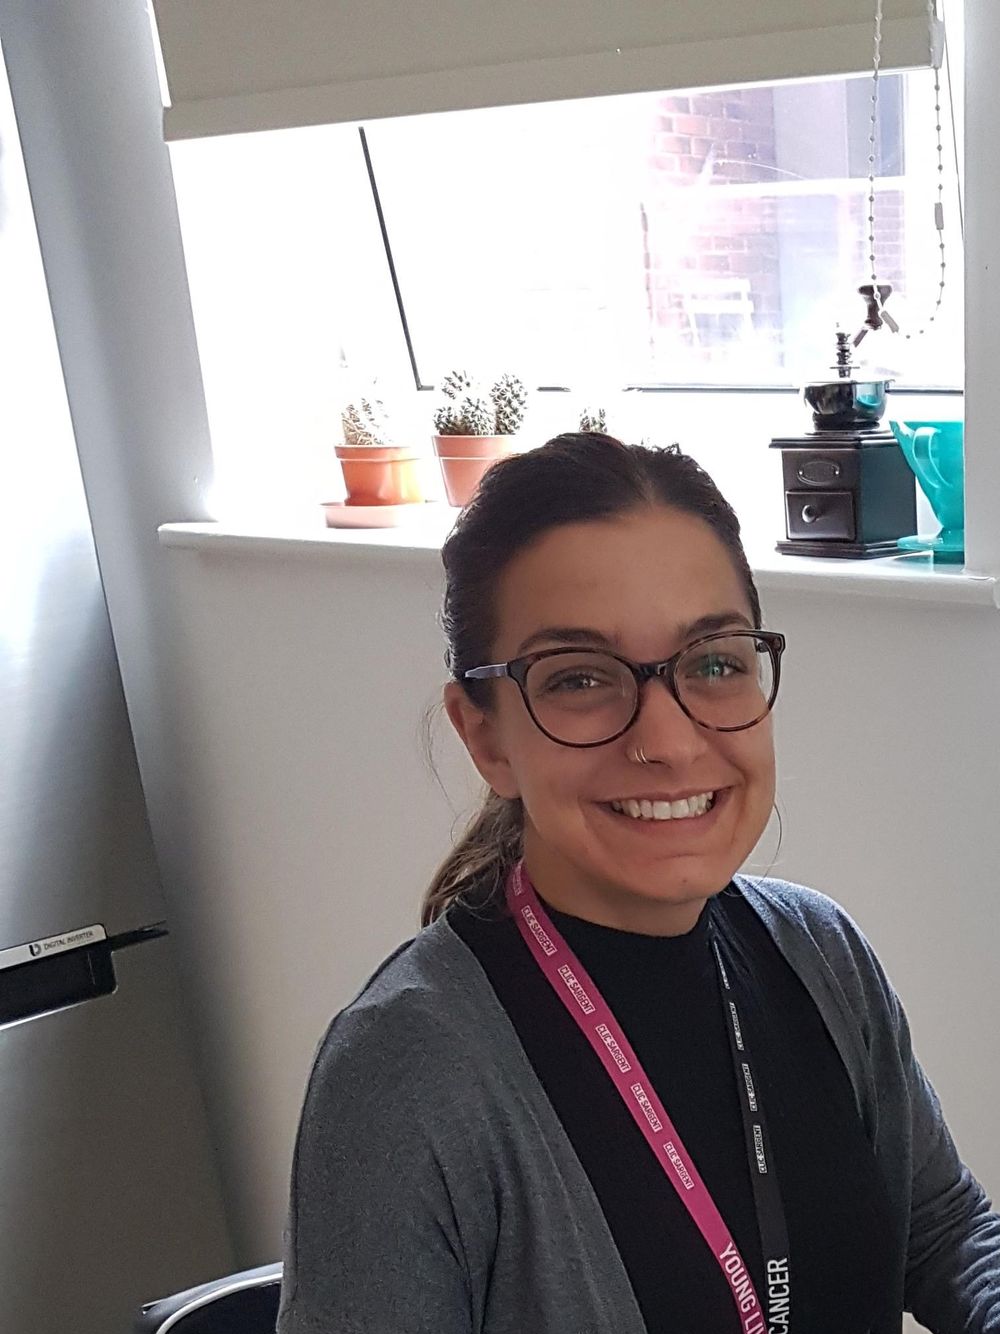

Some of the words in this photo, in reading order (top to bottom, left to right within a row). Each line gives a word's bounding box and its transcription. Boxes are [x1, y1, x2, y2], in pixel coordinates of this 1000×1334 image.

[560, 966, 574, 983] CLIC
[570, 981, 594, 1012] SARGENT
[597, 1025, 611, 1041] CLIC
[607, 1040, 629, 1071] SARGENT
[633, 1084, 645, 1101] CLIC
[641, 1100, 662, 1131] SARGENT
[665, 1143, 676, 1159] CLIC
[674, 1158, 694, 1188] SARGENT
[720, 1242, 756, 1313] YOUNG
